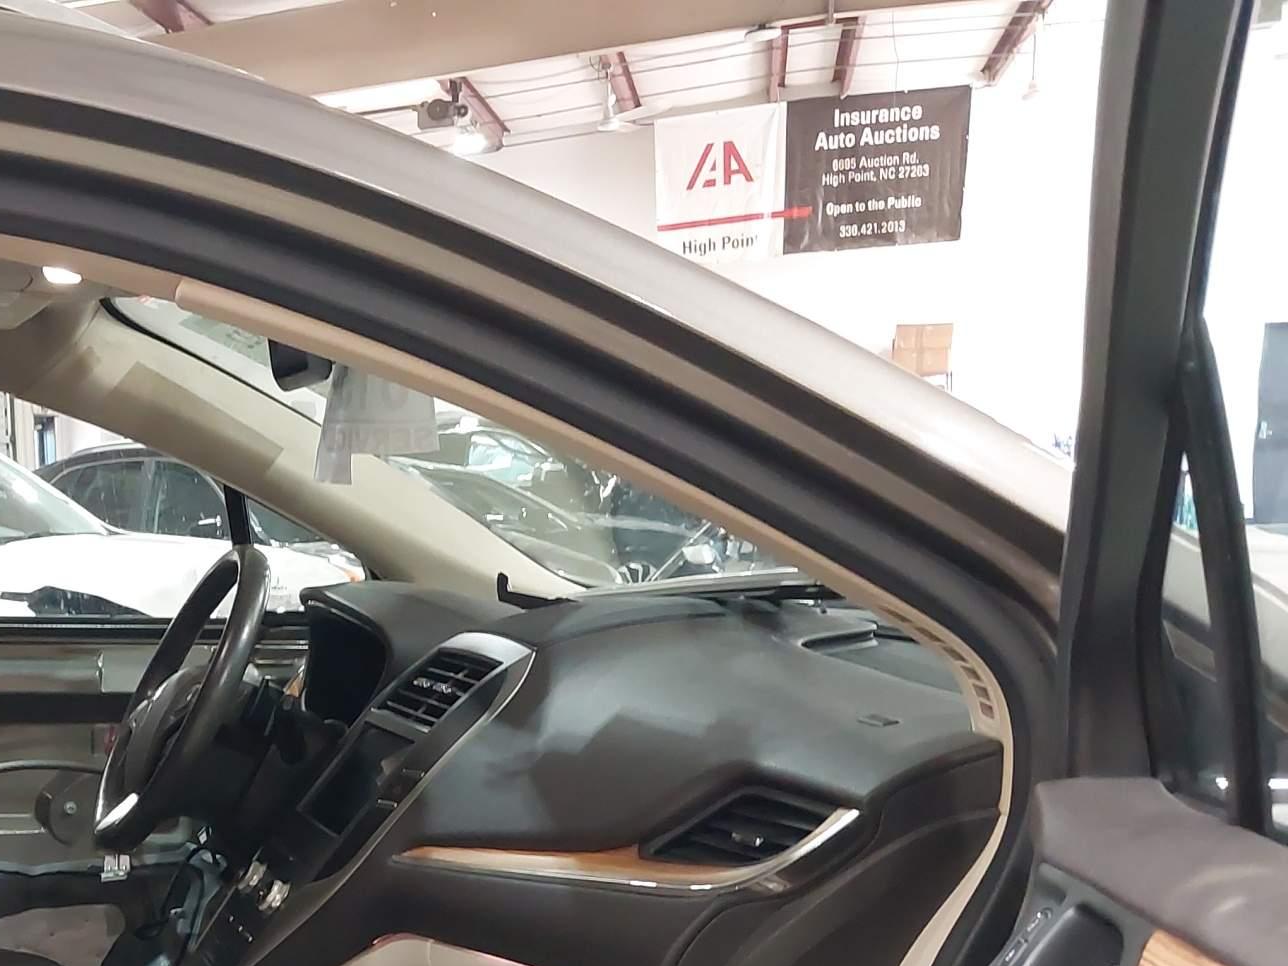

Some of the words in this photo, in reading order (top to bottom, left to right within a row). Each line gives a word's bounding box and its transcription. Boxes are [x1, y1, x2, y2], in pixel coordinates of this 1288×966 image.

[833, 104, 923, 128] Insurance
[814, 131, 856, 151] Auto
[859, 123, 941, 147] Auctions
[859, 154, 899, 169] Auction
[822, 172, 845, 188] High
[879, 166, 896, 181] NC
[826, 201, 853, 217] Open
[855, 200, 866, 212] to
[868, 197, 885, 211] the
[887, 194, 922, 210] Public
[682, 237, 716, 257] High
